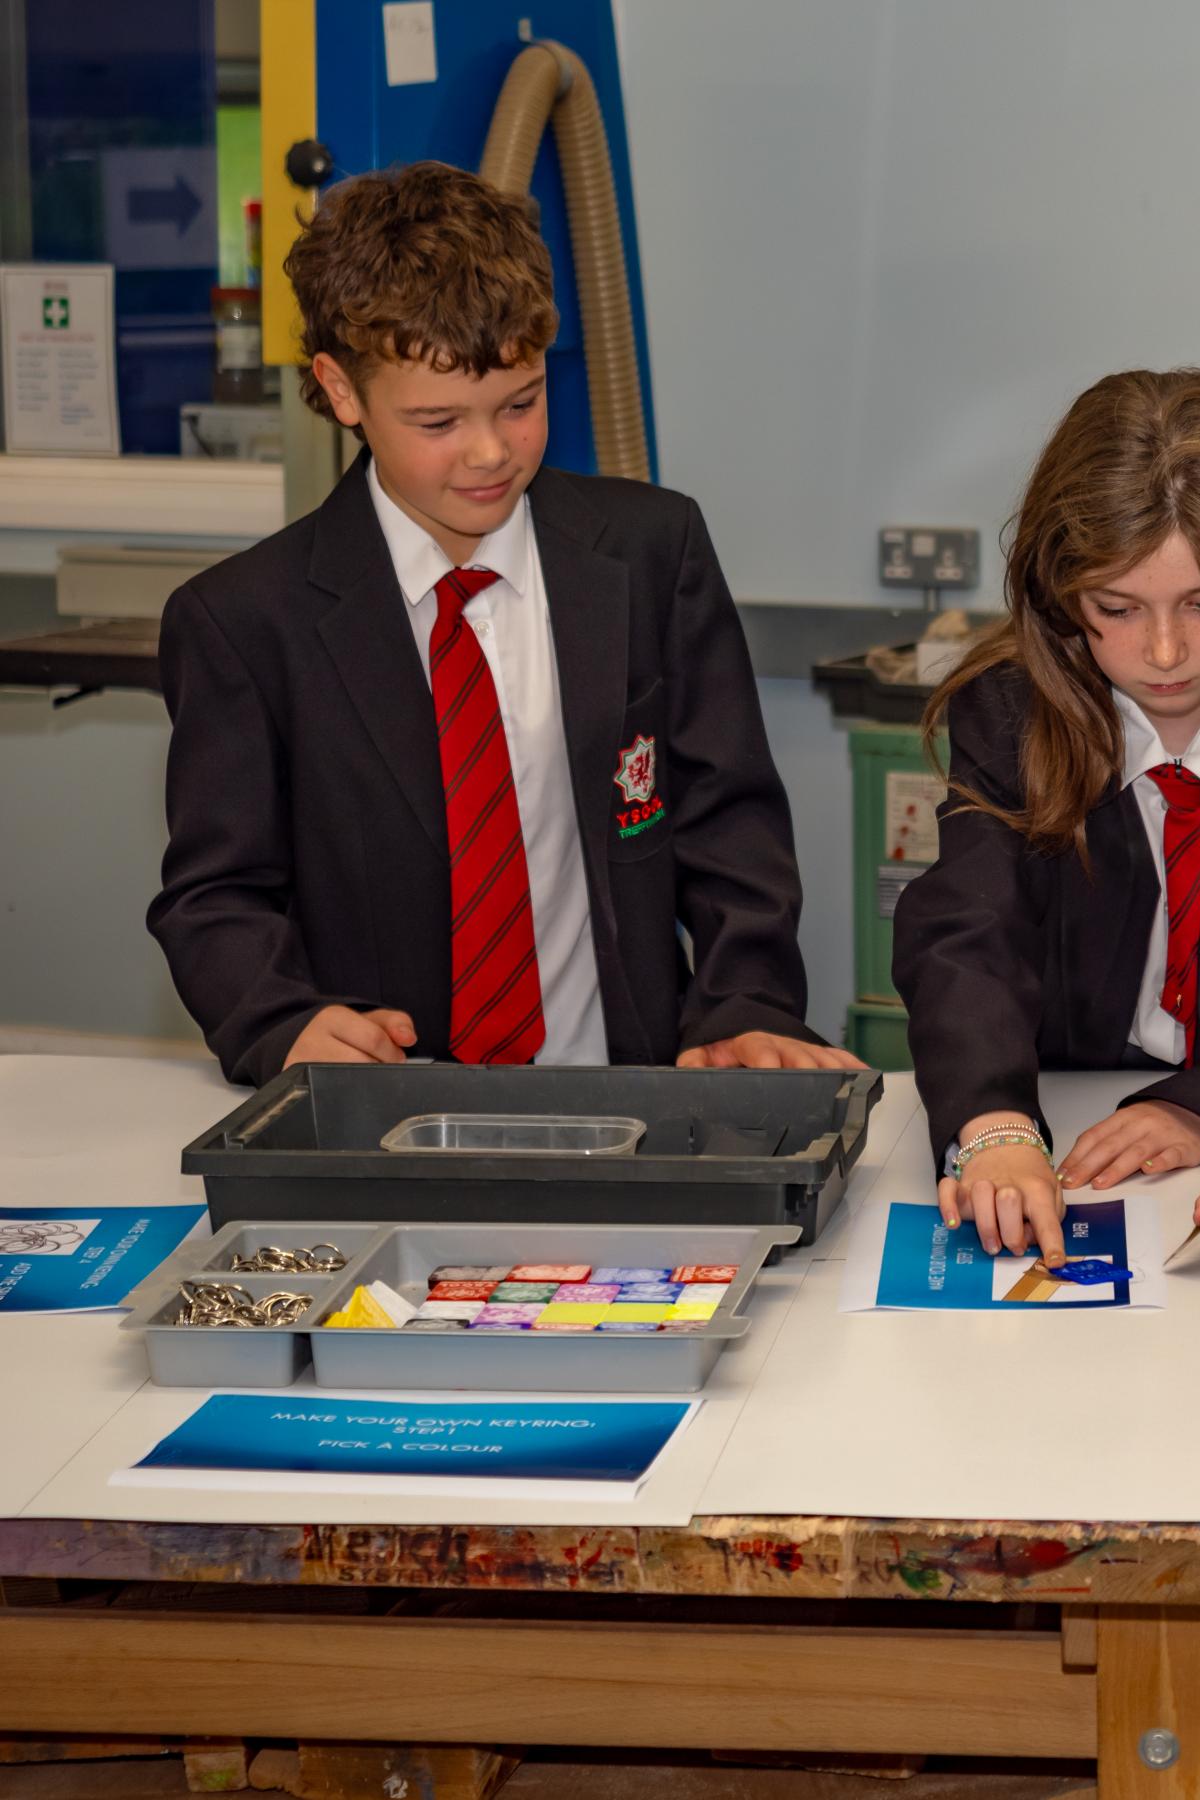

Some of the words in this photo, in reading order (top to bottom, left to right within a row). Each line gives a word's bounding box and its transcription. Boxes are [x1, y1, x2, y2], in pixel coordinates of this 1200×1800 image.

[270, 1413, 338, 1423] MAKE
[346, 1416, 409, 1425] YOUR
[416, 1418, 482, 1427] OWN
[392, 1426, 445, 1436] STEP
[317, 1439, 371, 1449] PICK
[375, 1441, 393, 1451] A
[402, 1443, 503, 1454] COLOUR
[338, 1566, 469, 1585] SYSTEMS
